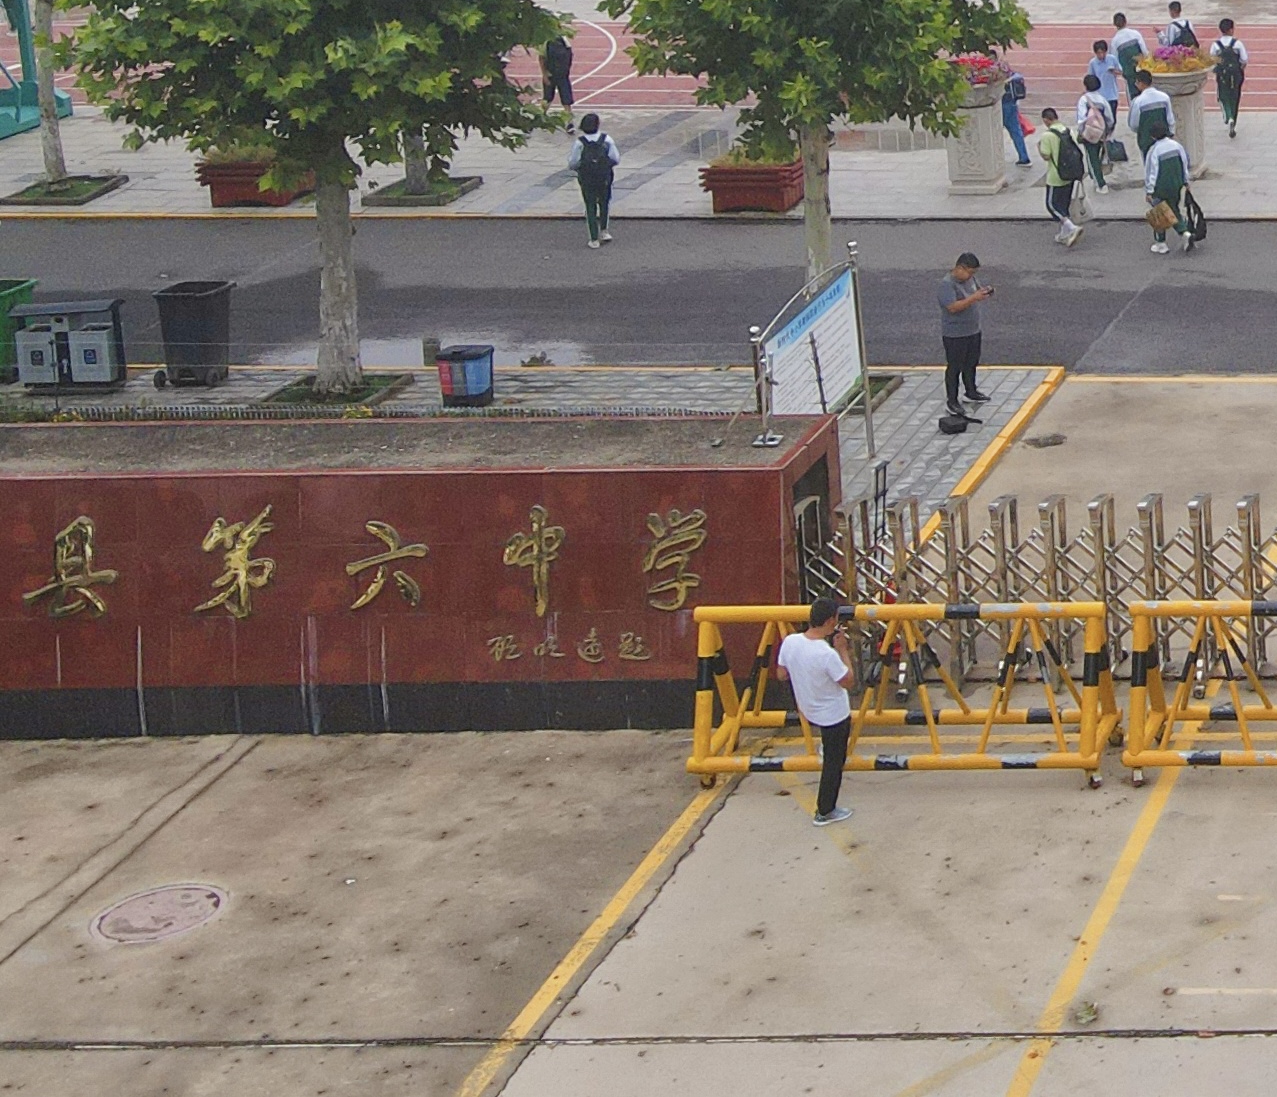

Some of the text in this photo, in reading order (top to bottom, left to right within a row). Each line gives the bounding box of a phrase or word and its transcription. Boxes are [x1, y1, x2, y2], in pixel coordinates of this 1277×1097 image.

[22, 504, 711, 619] 县第六中学
